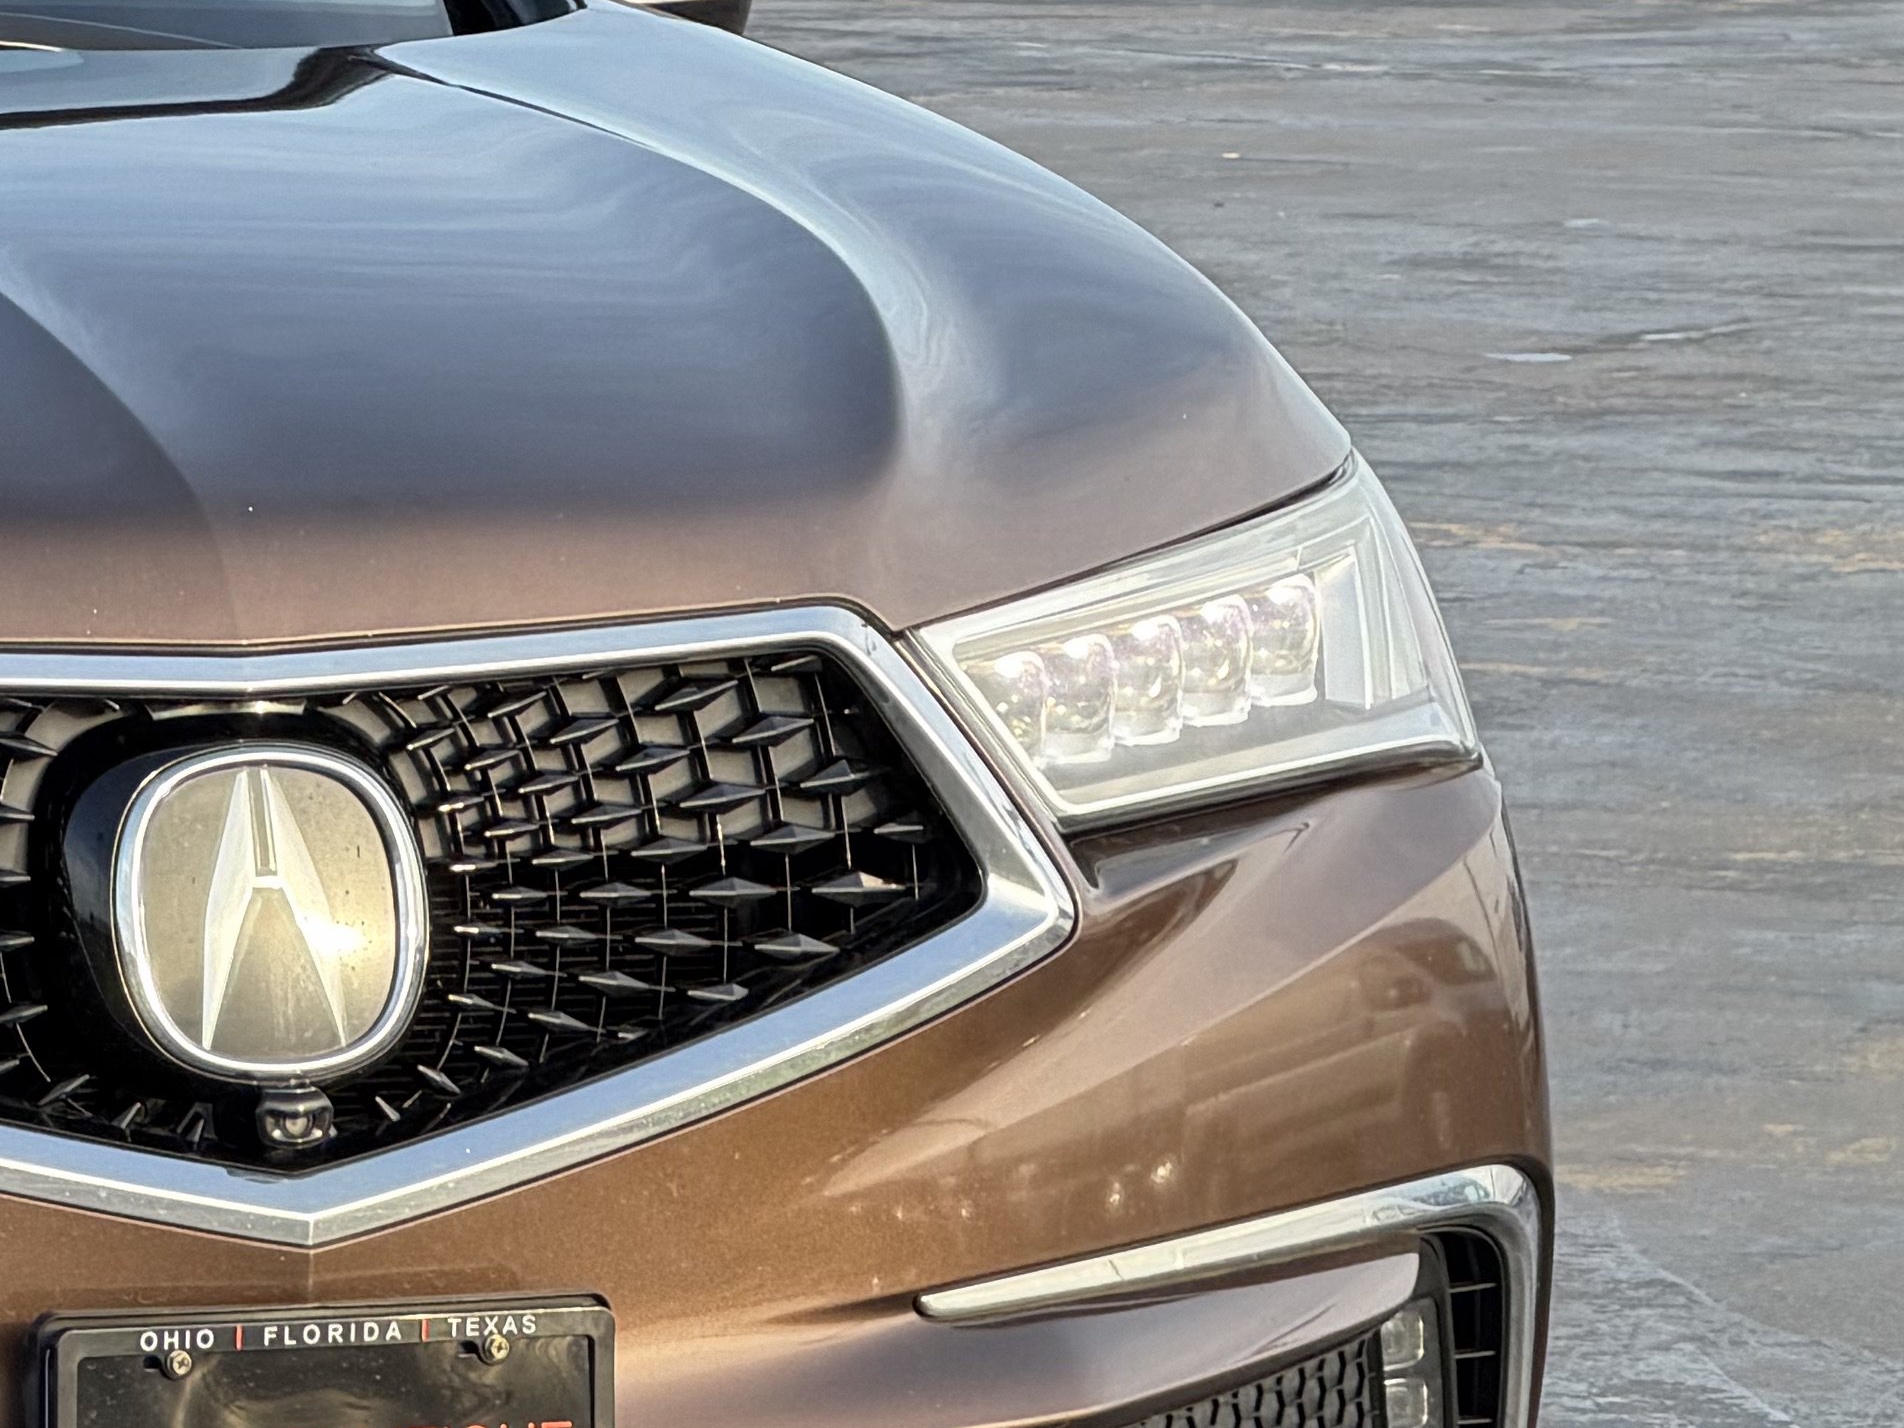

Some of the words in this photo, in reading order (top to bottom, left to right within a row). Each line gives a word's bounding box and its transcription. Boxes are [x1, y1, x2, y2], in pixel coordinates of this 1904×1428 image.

[139, 1328, 216, 1353] OHIO
[263, 1320, 403, 1347] FLORIDA
[447, 1315, 538, 1339] TEXAS
